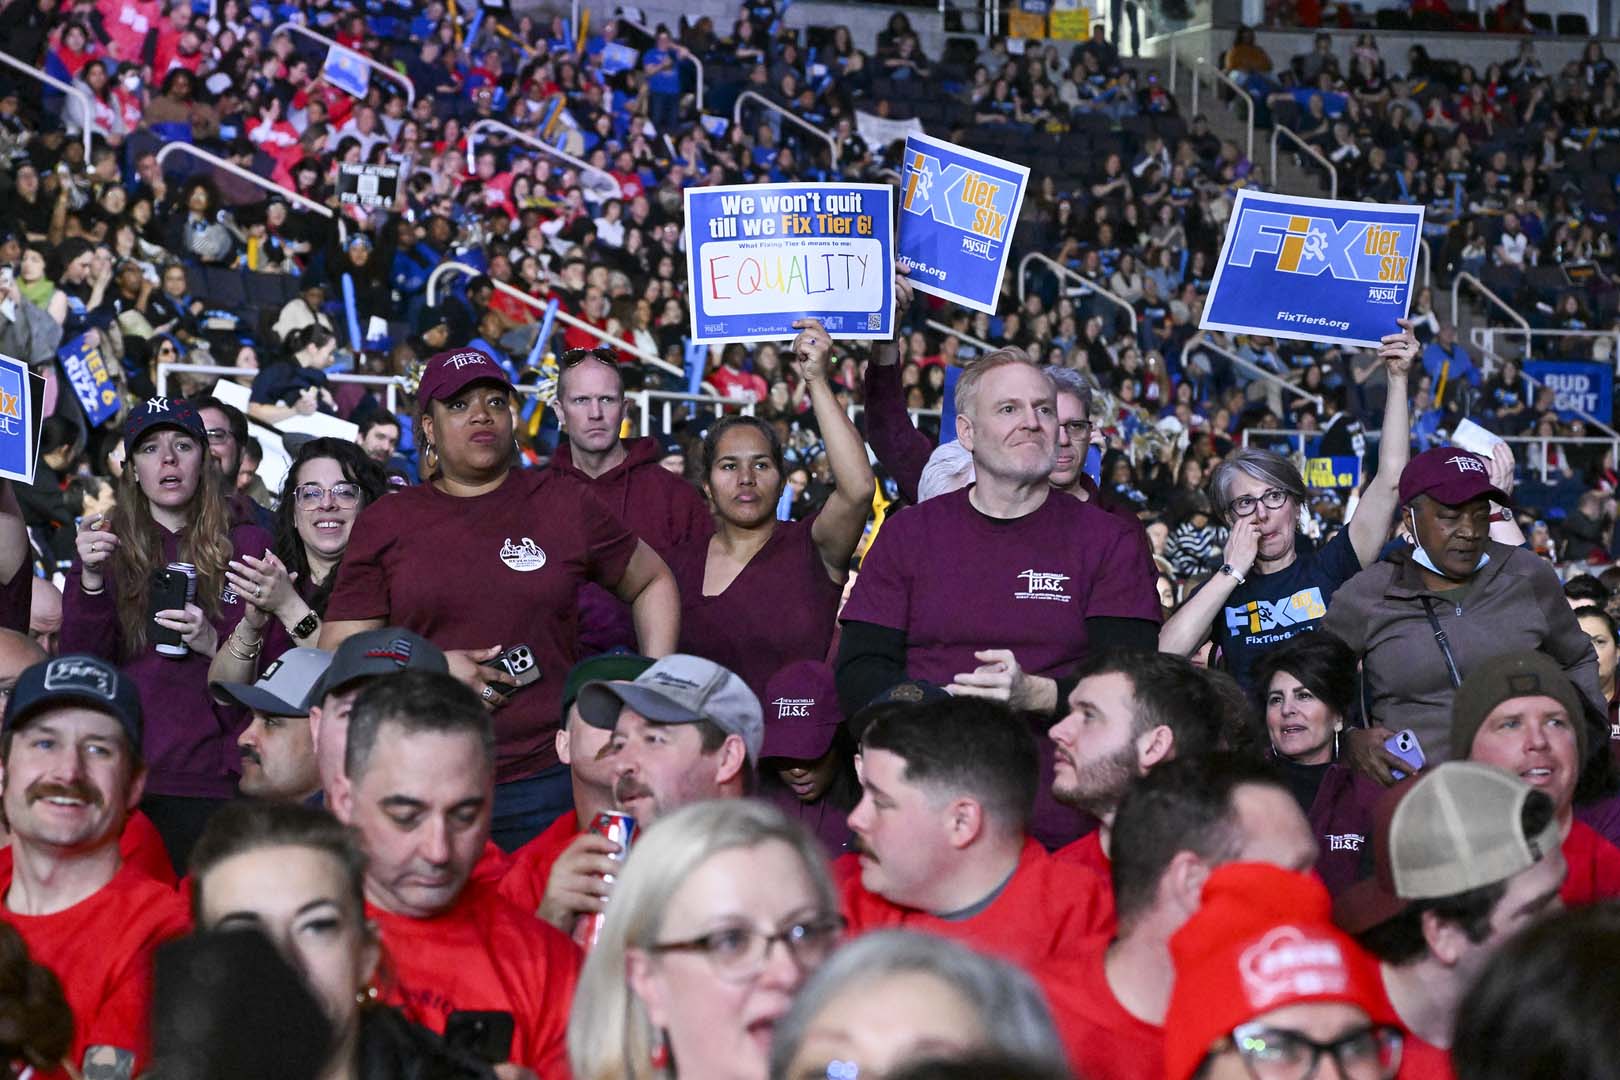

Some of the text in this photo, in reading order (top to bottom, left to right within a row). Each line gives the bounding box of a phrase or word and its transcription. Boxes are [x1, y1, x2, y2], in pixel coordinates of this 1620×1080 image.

[365, 166, 397, 178] ACTION
[961, 172, 999, 209] tier
[721, 192, 862, 216] We won't quit
[709, 214, 872, 238] till we Fix Tier 6!
[972, 208, 1007, 239] six
[760, 242, 783, 250] Fixing
[1364, 225, 1400, 257] tier
[709, 254, 869, 299] EQUALITY
[1378, 253, 1408, 282] six
[1368, 285, 1405, 305] nysut
[1277, 311, 1350, 331] FixTier6.org
[1545, 374, 1590, 392] BUD
[146, 397, 170, 414] NY
[1554, 393, 1599, 412] GHT
